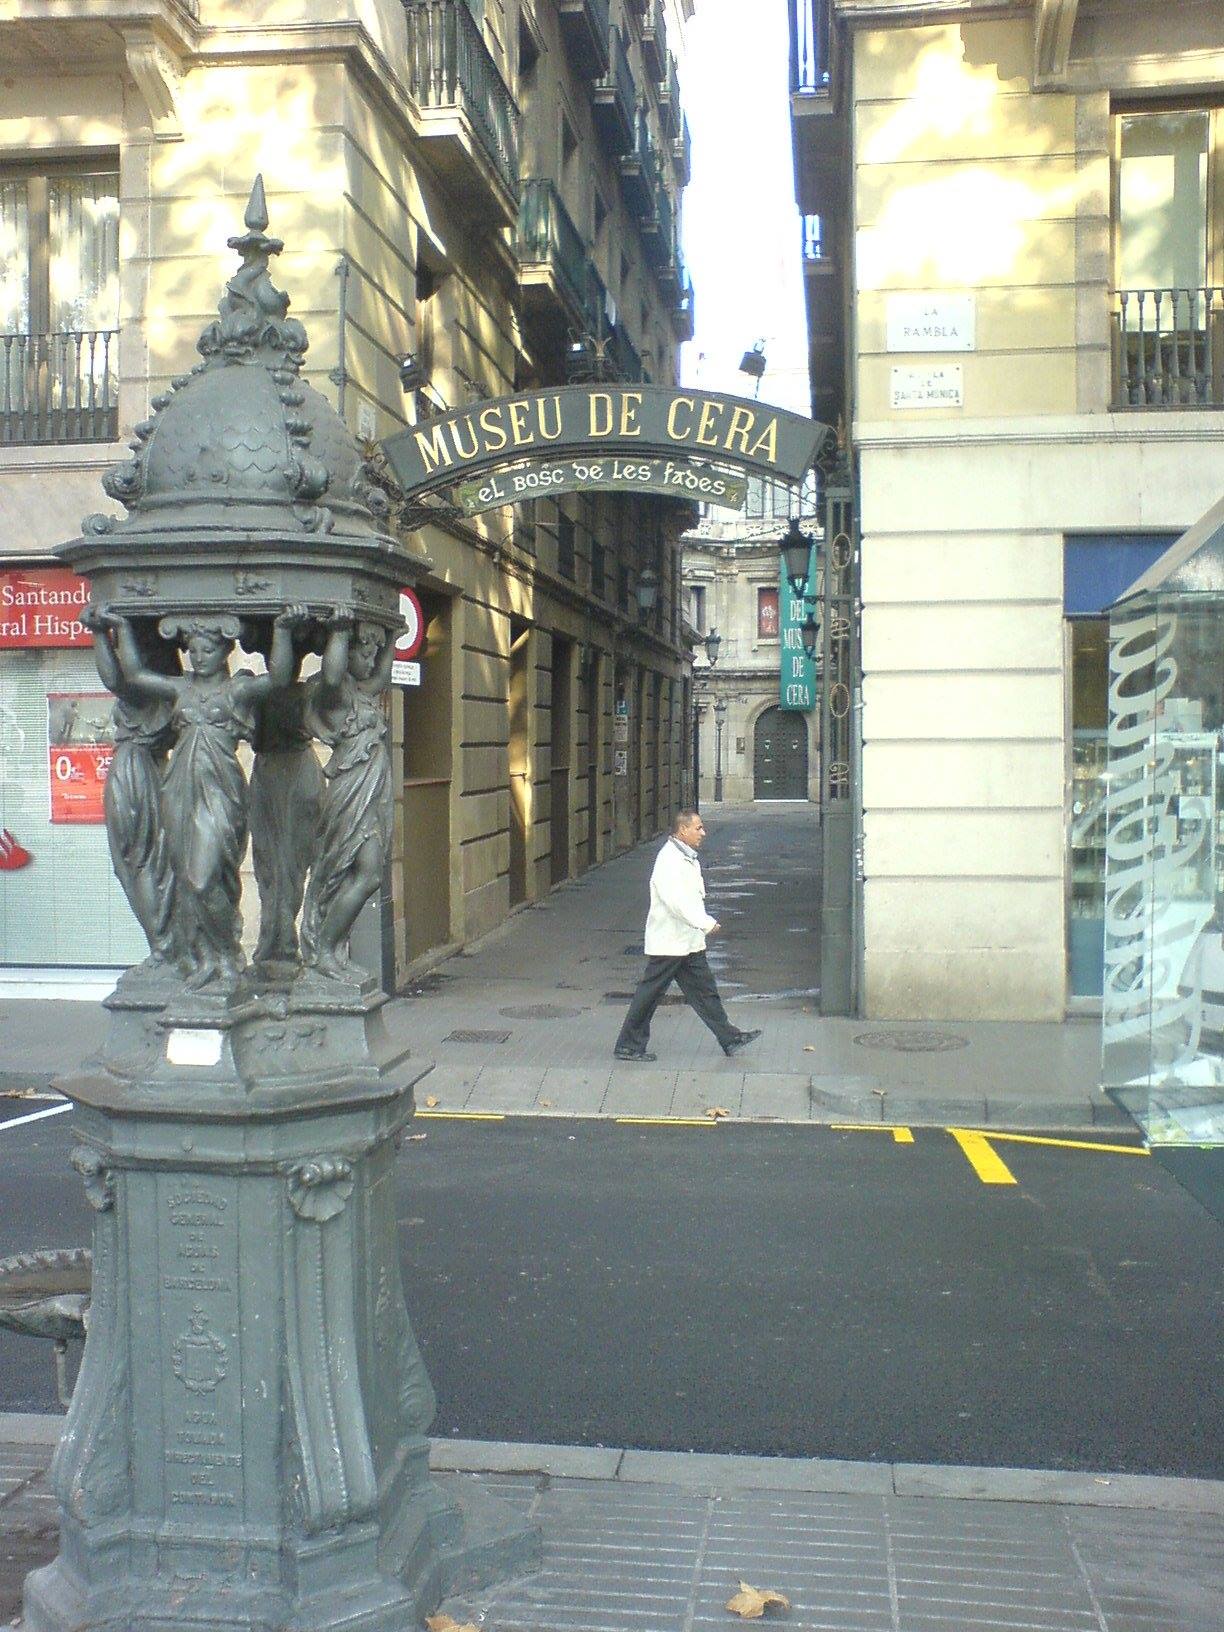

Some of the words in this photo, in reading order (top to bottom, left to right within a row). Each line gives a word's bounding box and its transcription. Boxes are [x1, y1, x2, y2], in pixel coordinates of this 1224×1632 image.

[903, 326, 959, 337] RAMBLA
[414, 396, 563, 474] MUSEU
[588, 393, 642, 437] DE
[667, 397, 778, 463] CERA
[663, 463, 726, 496] fades
[790, 599, 807, 622] DEL
[0, 613, 27, 636] ral
[792, 656, 804, 678] DE
[786, 685, 810, 705] CERA
